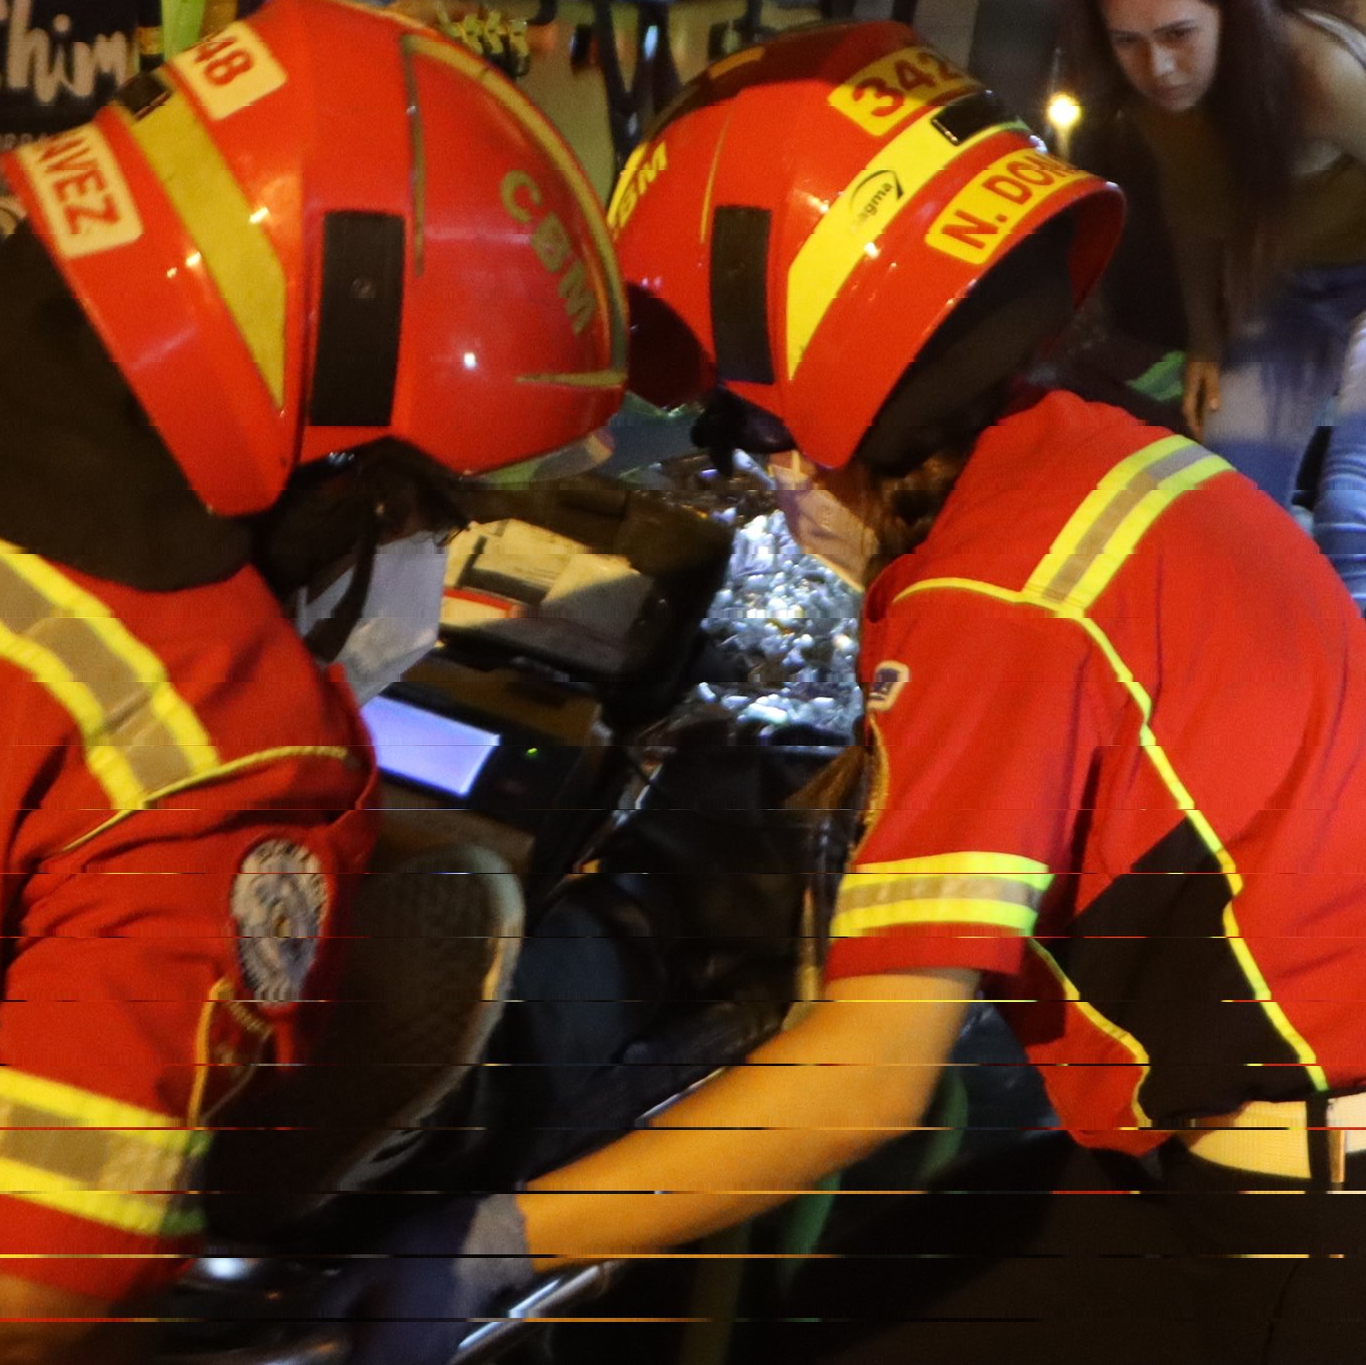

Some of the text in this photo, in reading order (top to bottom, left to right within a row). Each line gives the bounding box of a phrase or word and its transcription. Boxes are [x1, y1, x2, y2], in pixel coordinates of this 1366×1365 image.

[851, 50, 963, 118] 342
[500, 169, 596, 338] CBM
[941, 209, 1007, 249] N.
